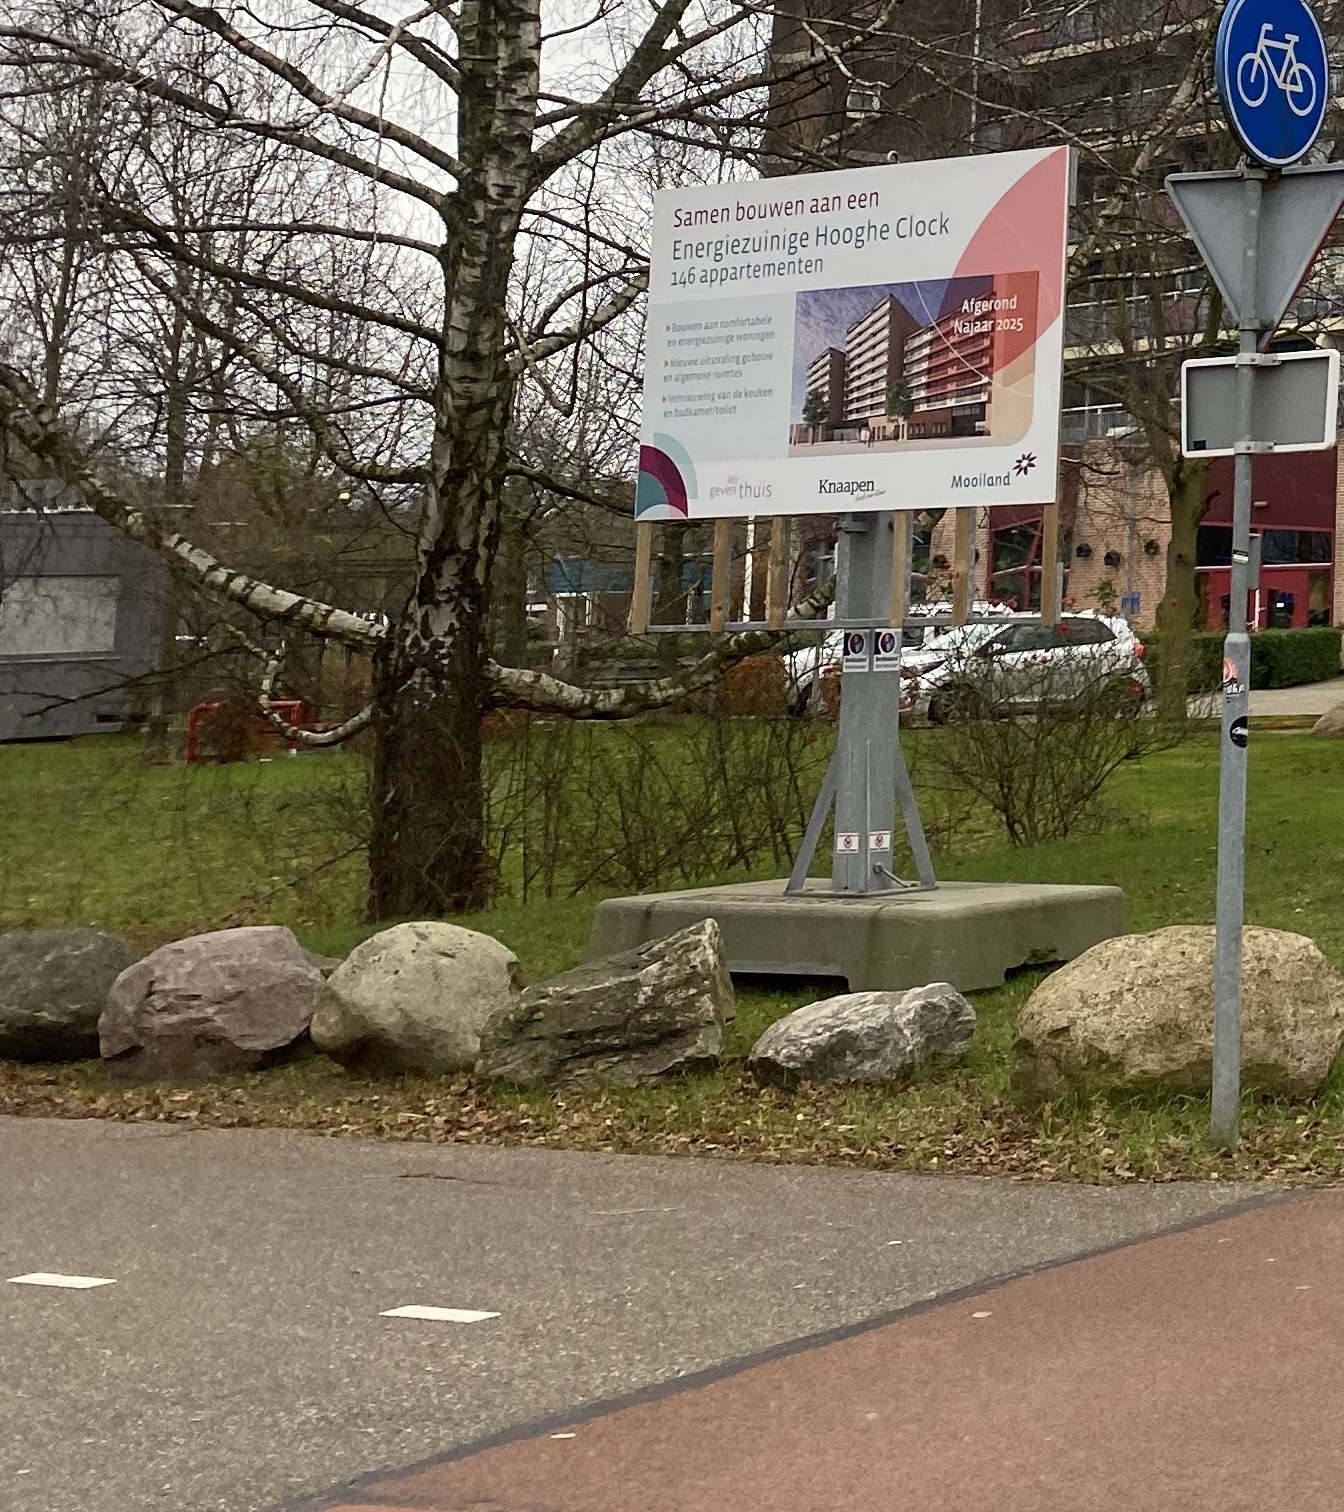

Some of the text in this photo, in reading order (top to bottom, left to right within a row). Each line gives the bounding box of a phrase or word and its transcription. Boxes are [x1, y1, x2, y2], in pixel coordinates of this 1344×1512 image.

[673, 190, 880, 228] Samen bouwen aan een
[672, 211, 950, 263] Energiezuinige Hooghe Clock
[670, 256, 824, 289] 146 appartementen
[961, 294, 1018, 316] Afgerond
[953, 317, 1024, 337] Najaar 2025
[667, 338, 677, 348] en
[663, 374, 673, 383] en
[818, 479, 875, 496] Knaapen
[950, 472, 1011, 489] Mooiland
[709, 481, 773, 500] geven thuis
